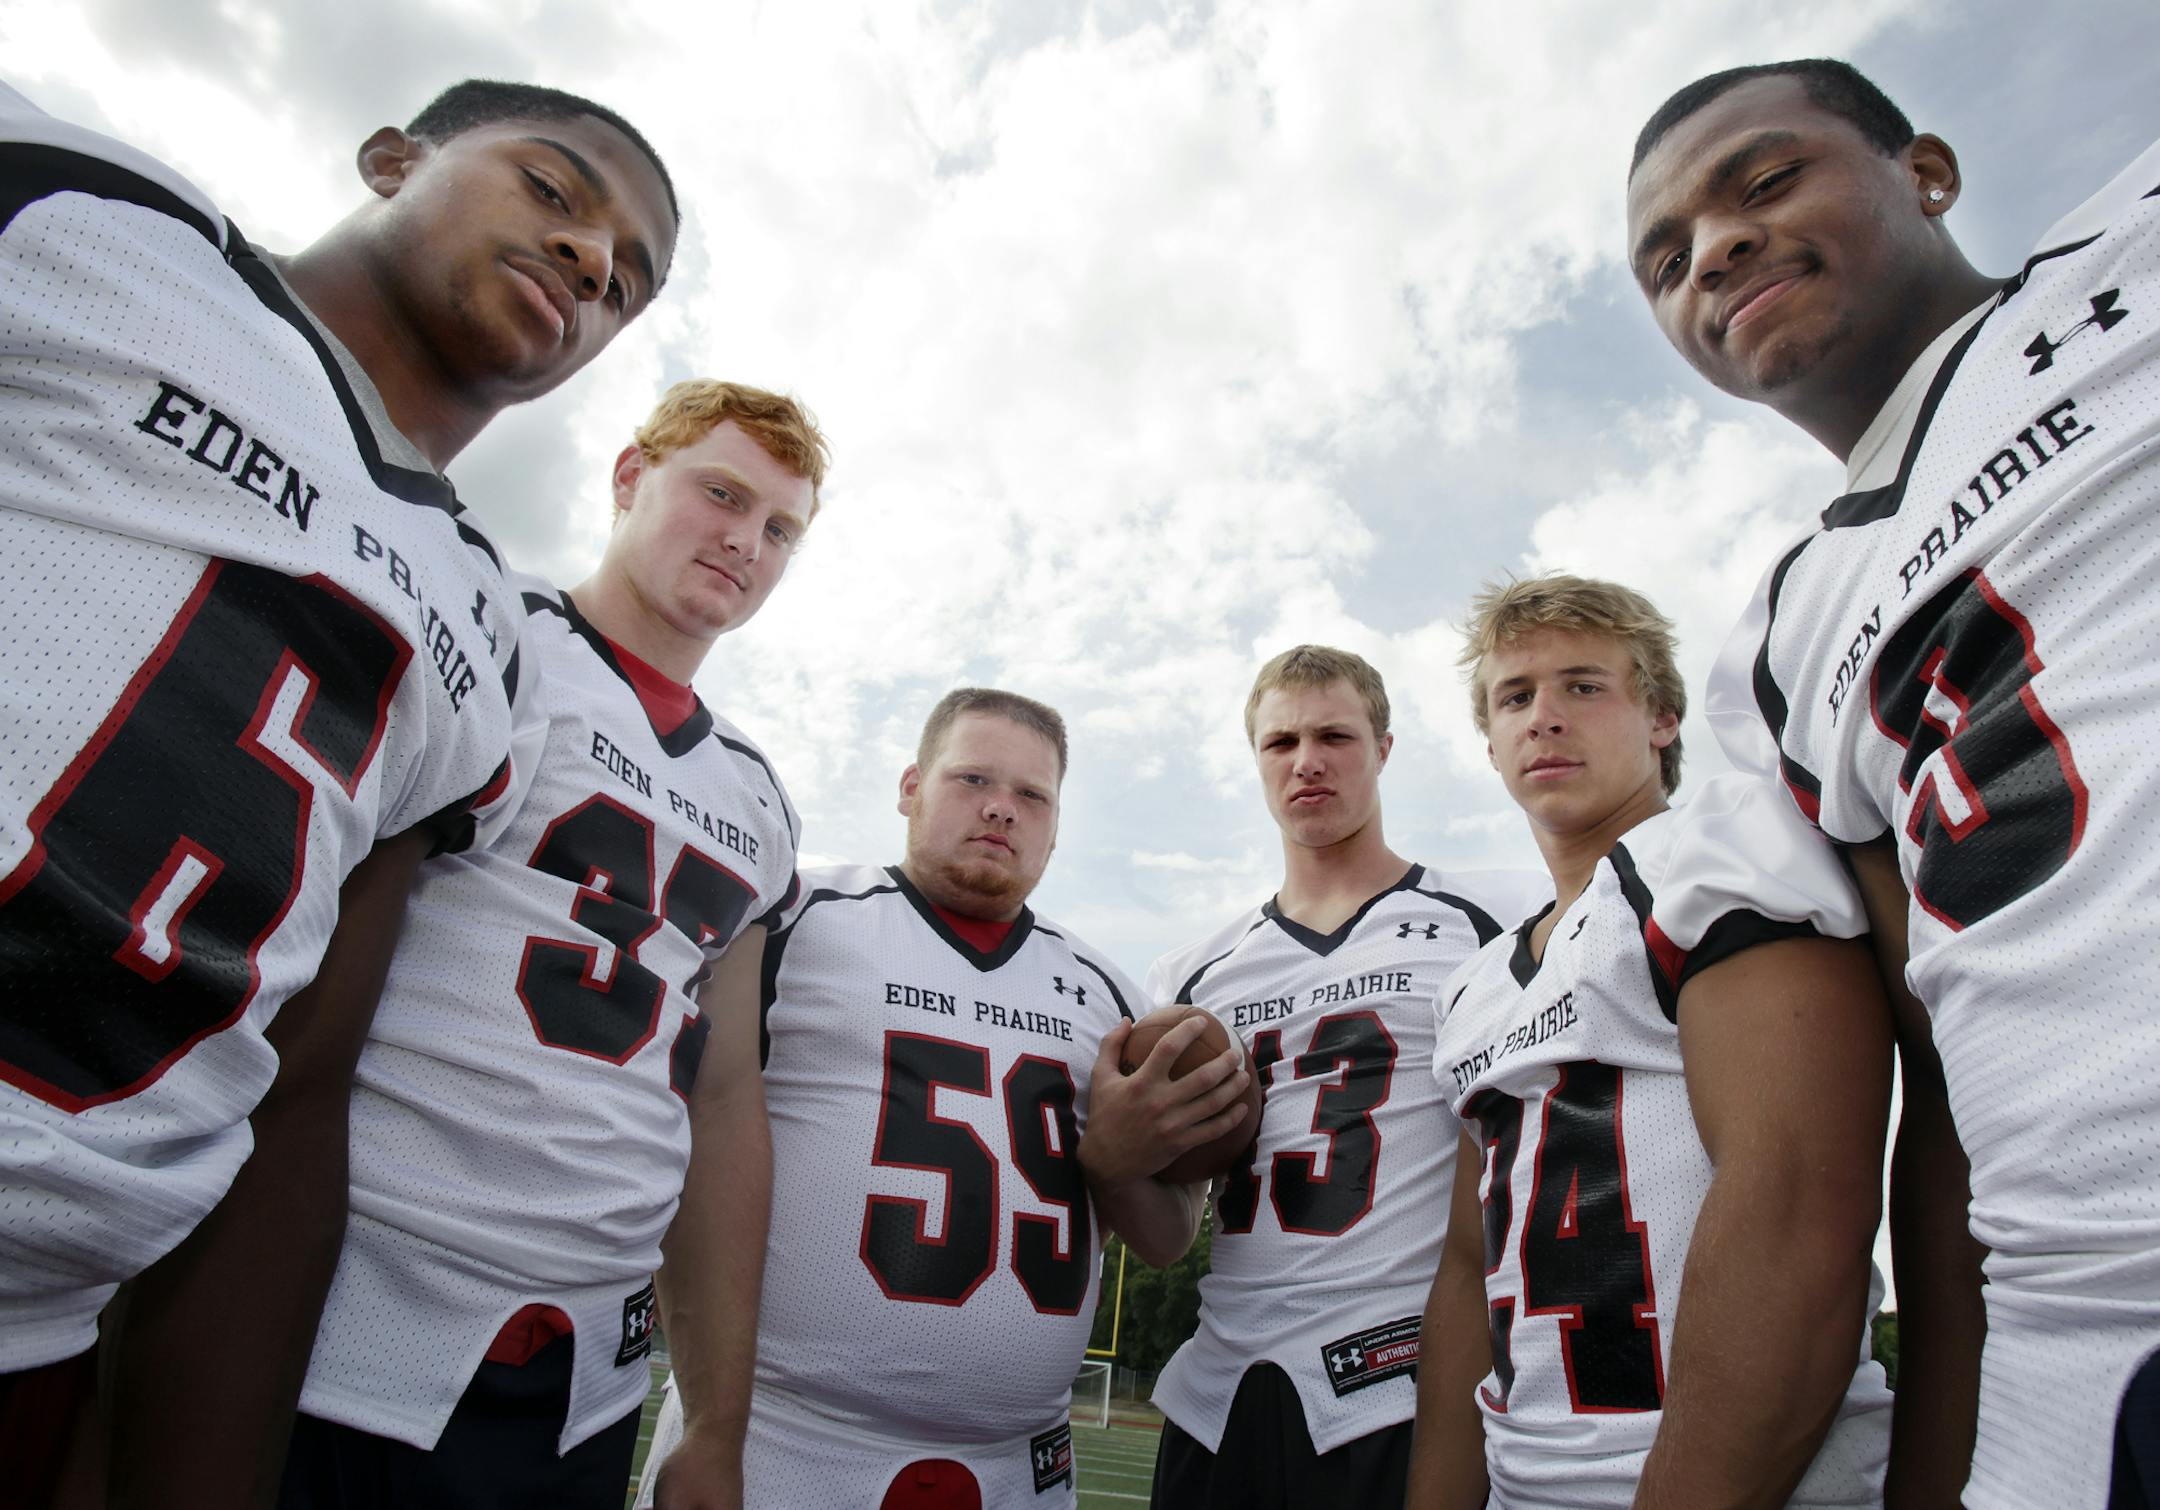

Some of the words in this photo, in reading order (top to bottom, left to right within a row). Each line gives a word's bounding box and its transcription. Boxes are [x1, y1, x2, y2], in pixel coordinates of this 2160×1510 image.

[135, 381, 320, 532] EDEN
[1828, 605, 1882, 727] EDEN
[1900, 398, 2095, 599] PRAIRIE
[590, 731, 653, 799] EDEN
[667, 789, 760, 865] PRAIRIE
[885, 983, 956, 1017] EDEN
[975, 1001, 1073, 1042] PRAIRIE
[1233, 996, 1295, 1028] EDEN
[1309, 972, 1412, 1007] PRAIRIE
[1452, 1044, 1495, 1096] EDEN
[1497, 991, 1578, 1060] PRAIRIE
[859, 1030, 1091, 1316] 59
[1218, 1010, 1398, 1237] 13
[1364, 1334, 1390, 1346] UNDER
